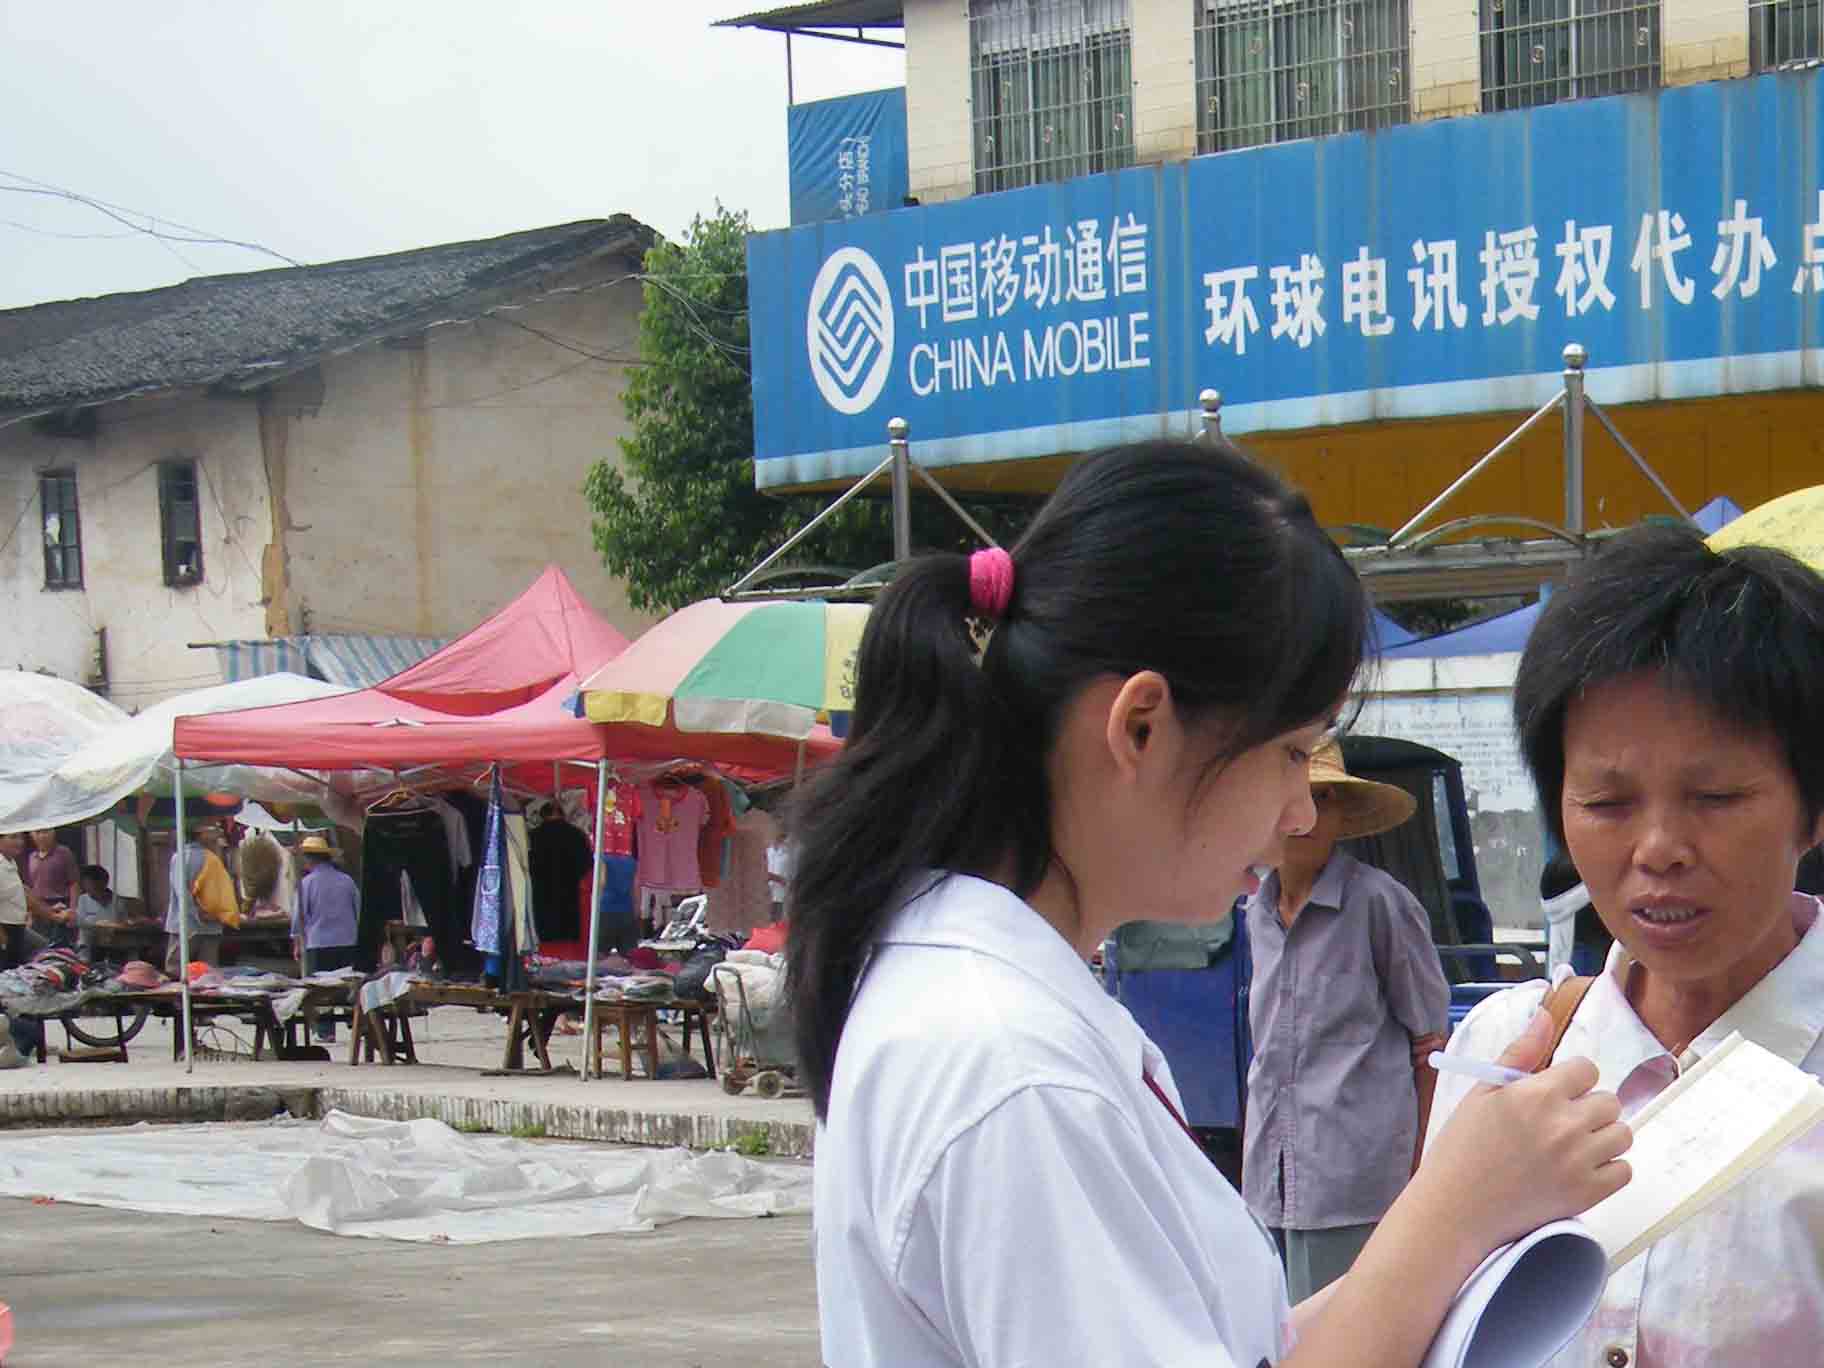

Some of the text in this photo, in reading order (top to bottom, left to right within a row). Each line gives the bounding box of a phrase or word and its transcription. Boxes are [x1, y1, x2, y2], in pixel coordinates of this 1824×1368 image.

[904, 212, 1148, 329] 中国移动通信
[909, 312, 1151, 396] CHINA MOBILE
